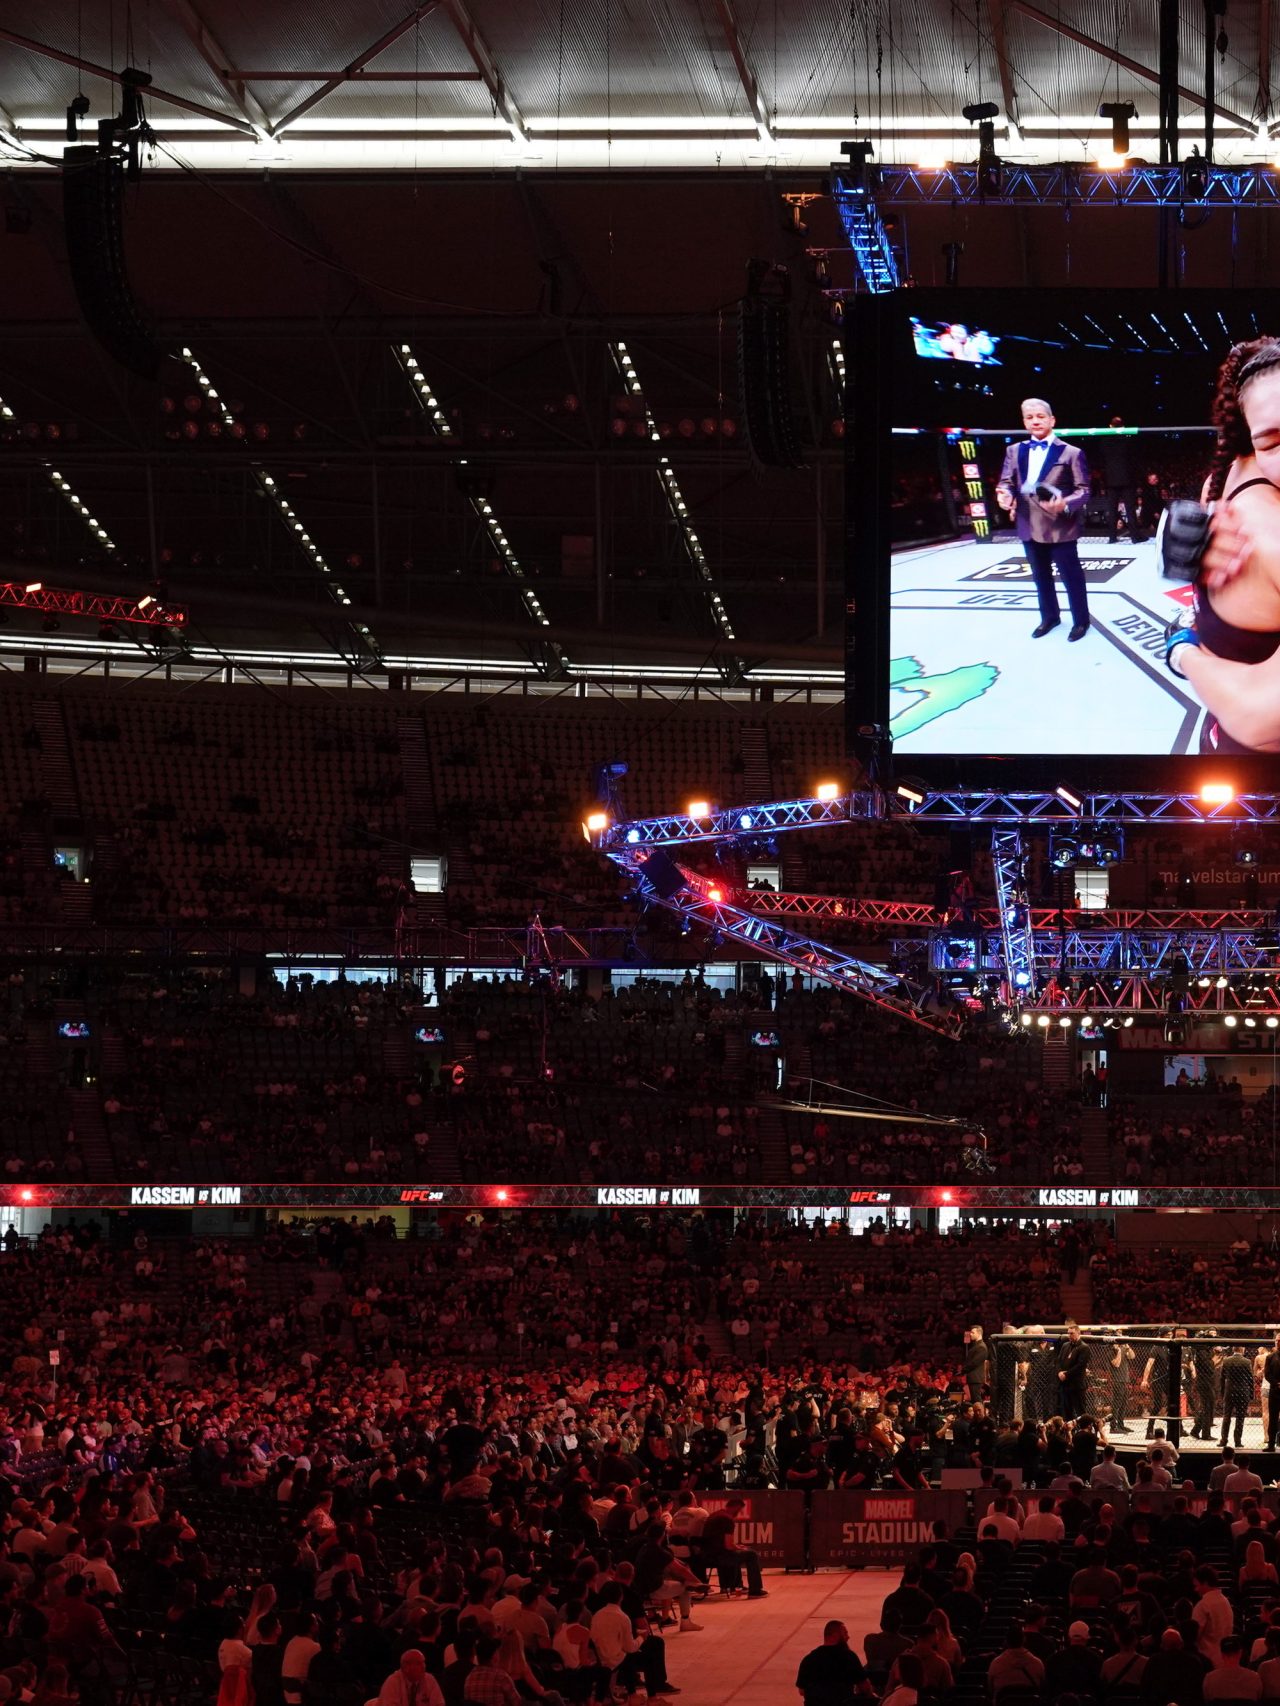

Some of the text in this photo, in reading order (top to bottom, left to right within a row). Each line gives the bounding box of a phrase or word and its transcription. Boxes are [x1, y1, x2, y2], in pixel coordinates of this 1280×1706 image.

[131, 1187, 195, 1205] KASSEM
[211, 1187, 241, 1205] KIM
[400, 1190, 443, 1201] UFC 243
[597, 1188, 656, 1205] KASSEM
[671, 1188, 700, 1205] KIM
[849, 1191, 891, 1202] UFC 243
[1038, 1189, 1097, 1206] KASSEM
[1111, 1189, 1139, 1206] KIM
[864, 1499, 913, 1519] MARVEL
[842, 1521, 937, 1543] STADIUM
